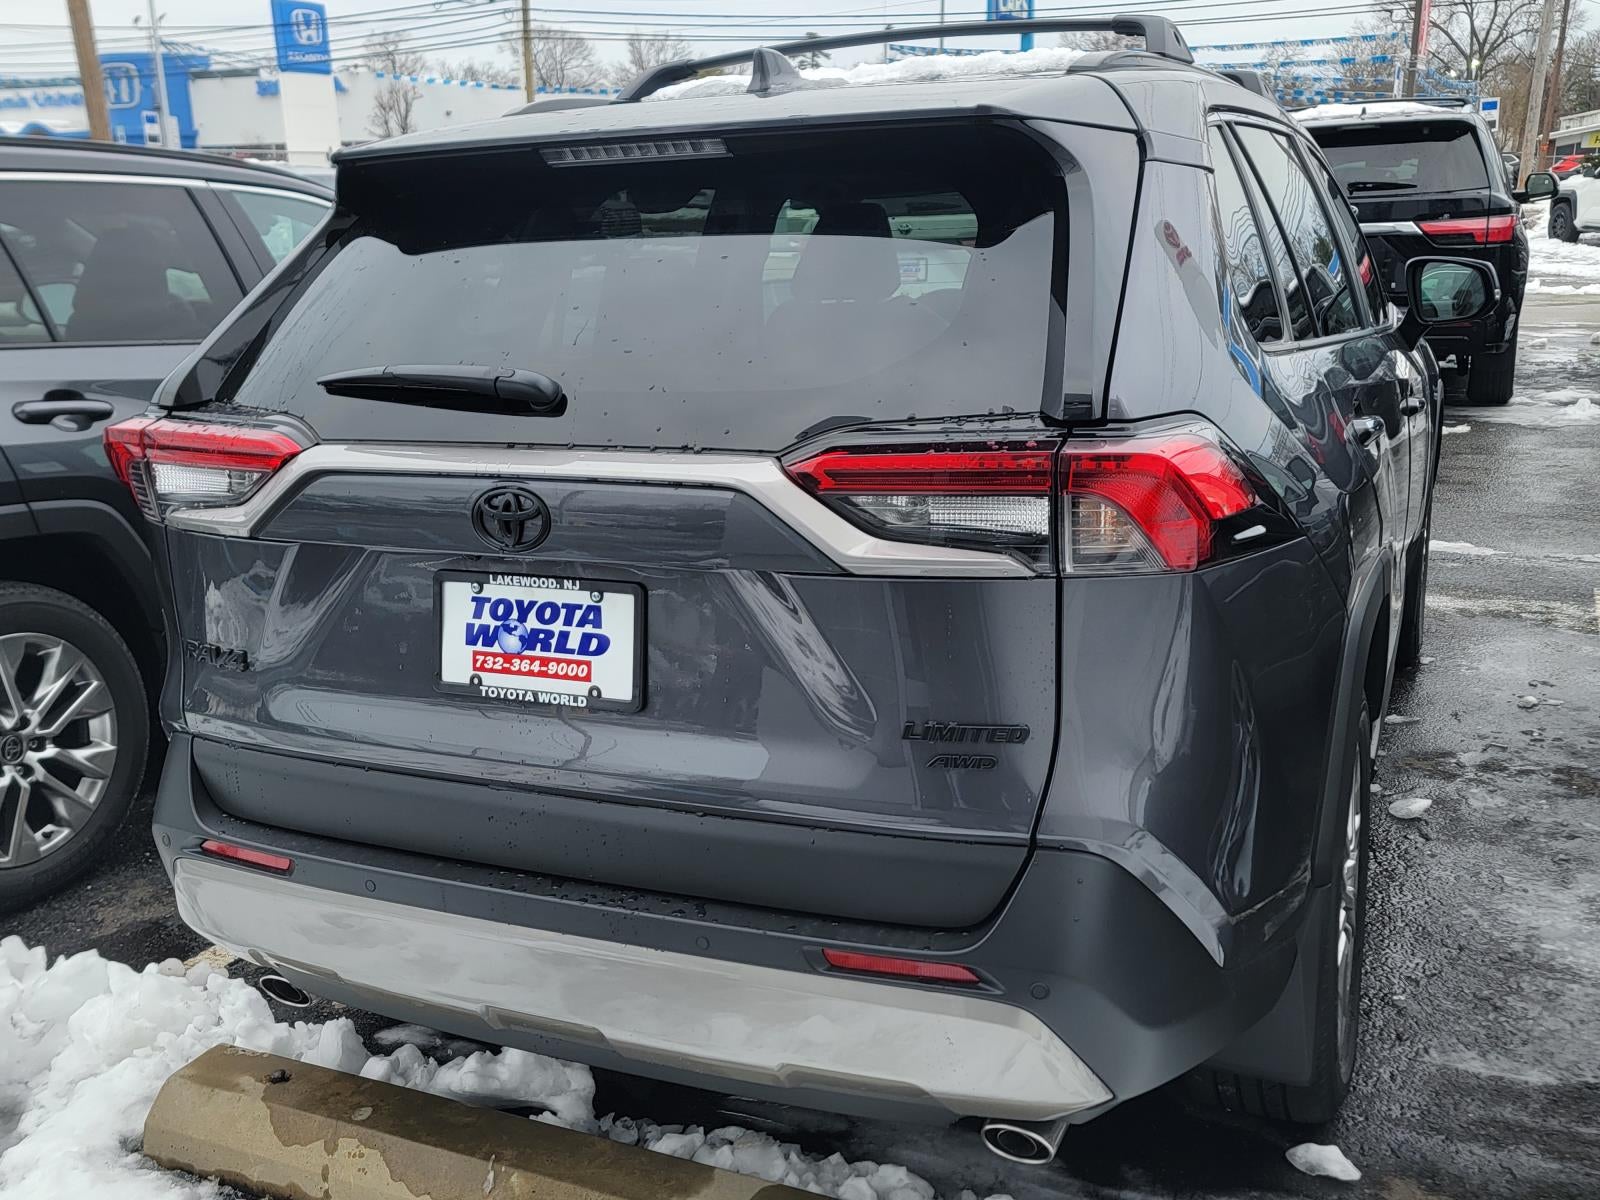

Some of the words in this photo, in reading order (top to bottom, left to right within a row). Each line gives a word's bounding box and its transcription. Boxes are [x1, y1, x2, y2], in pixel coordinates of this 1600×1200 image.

[489, 575, 560, 589] LAKEWOOD,
[563, 579, 580, 591] NJ
[470, 595, 603, 629] TOYOTA
[465, 620, 611, 657] WORLD
[186, 639, 250, 672] RAV4
[475, 654, 588, 678] 732-364-9000
[479, 685, 535, 702] TOYOTA
[537, 692, 587, 708] WORLD
[901, 720, 1031, 745] LIMITED
[926, 753, 999, 770] AWD
